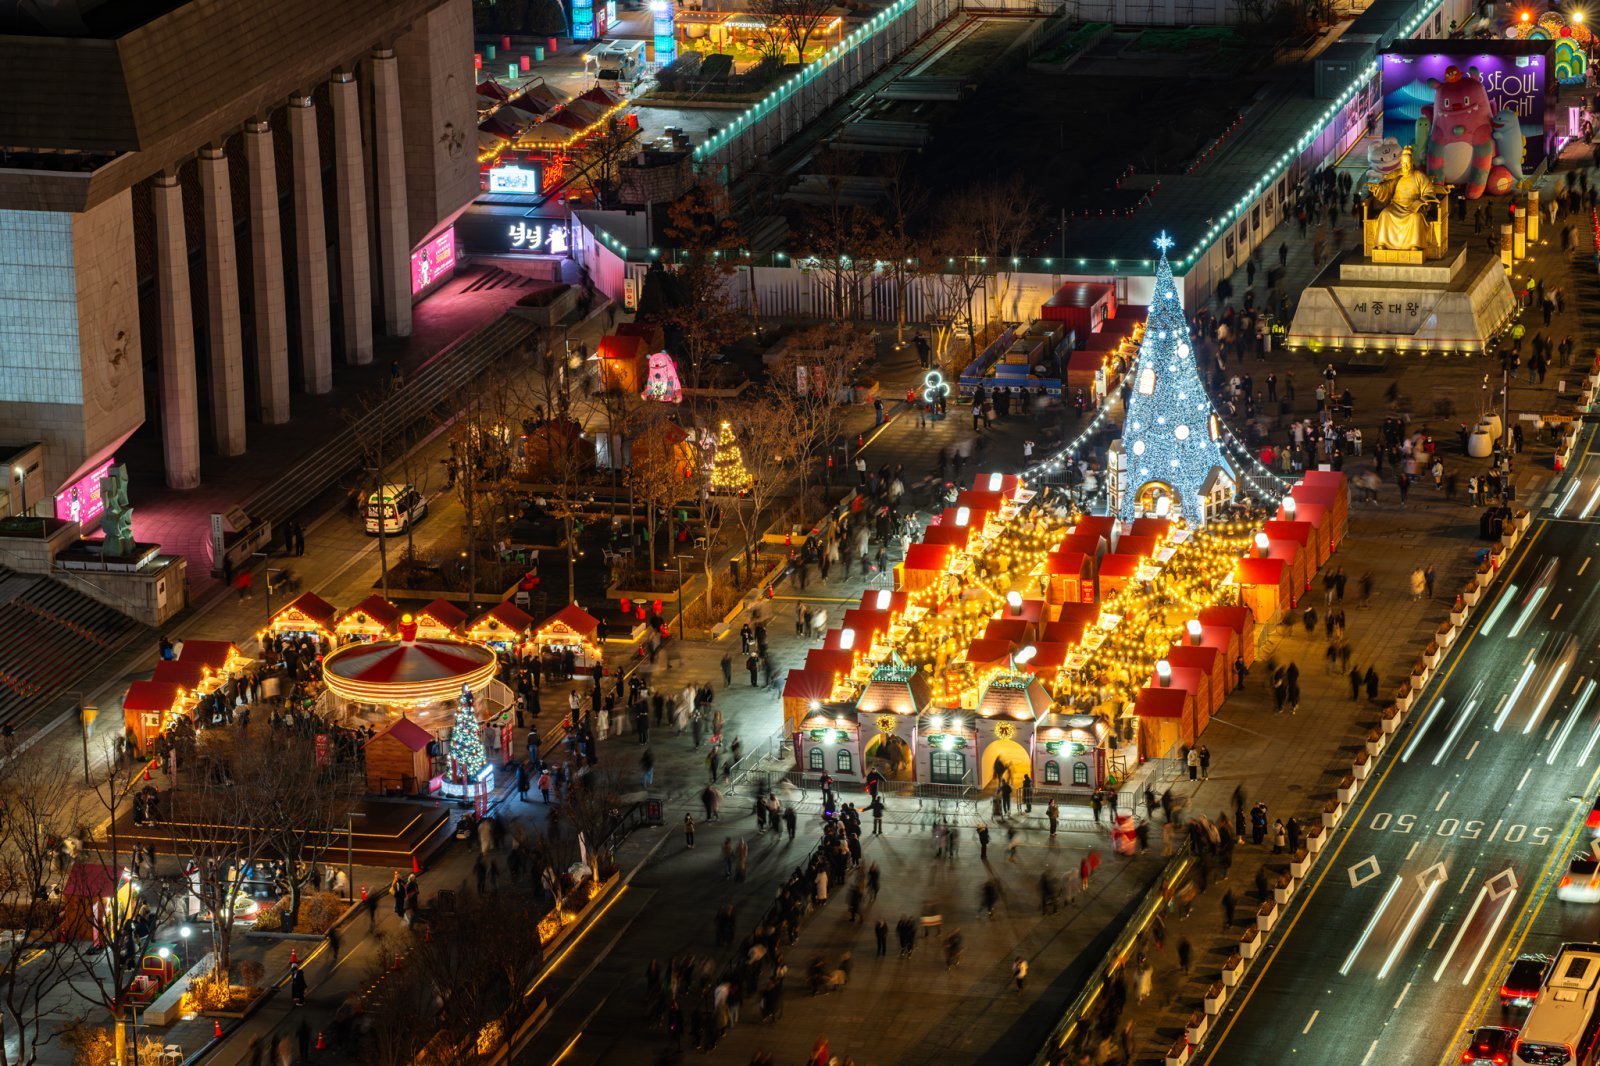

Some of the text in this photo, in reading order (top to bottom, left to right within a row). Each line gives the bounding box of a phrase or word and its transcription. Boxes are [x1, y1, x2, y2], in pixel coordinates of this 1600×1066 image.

[1487, 71, 1539, 96] SEOUL
[509, 222, 541, 249] 넉넉
[1353, 301, 1420, 317] 세종대왕
[1369, 812, 1418, 834] 50
[1436, 818, 1486, 840] 50
[1504, 824, 1553, 846] 50
